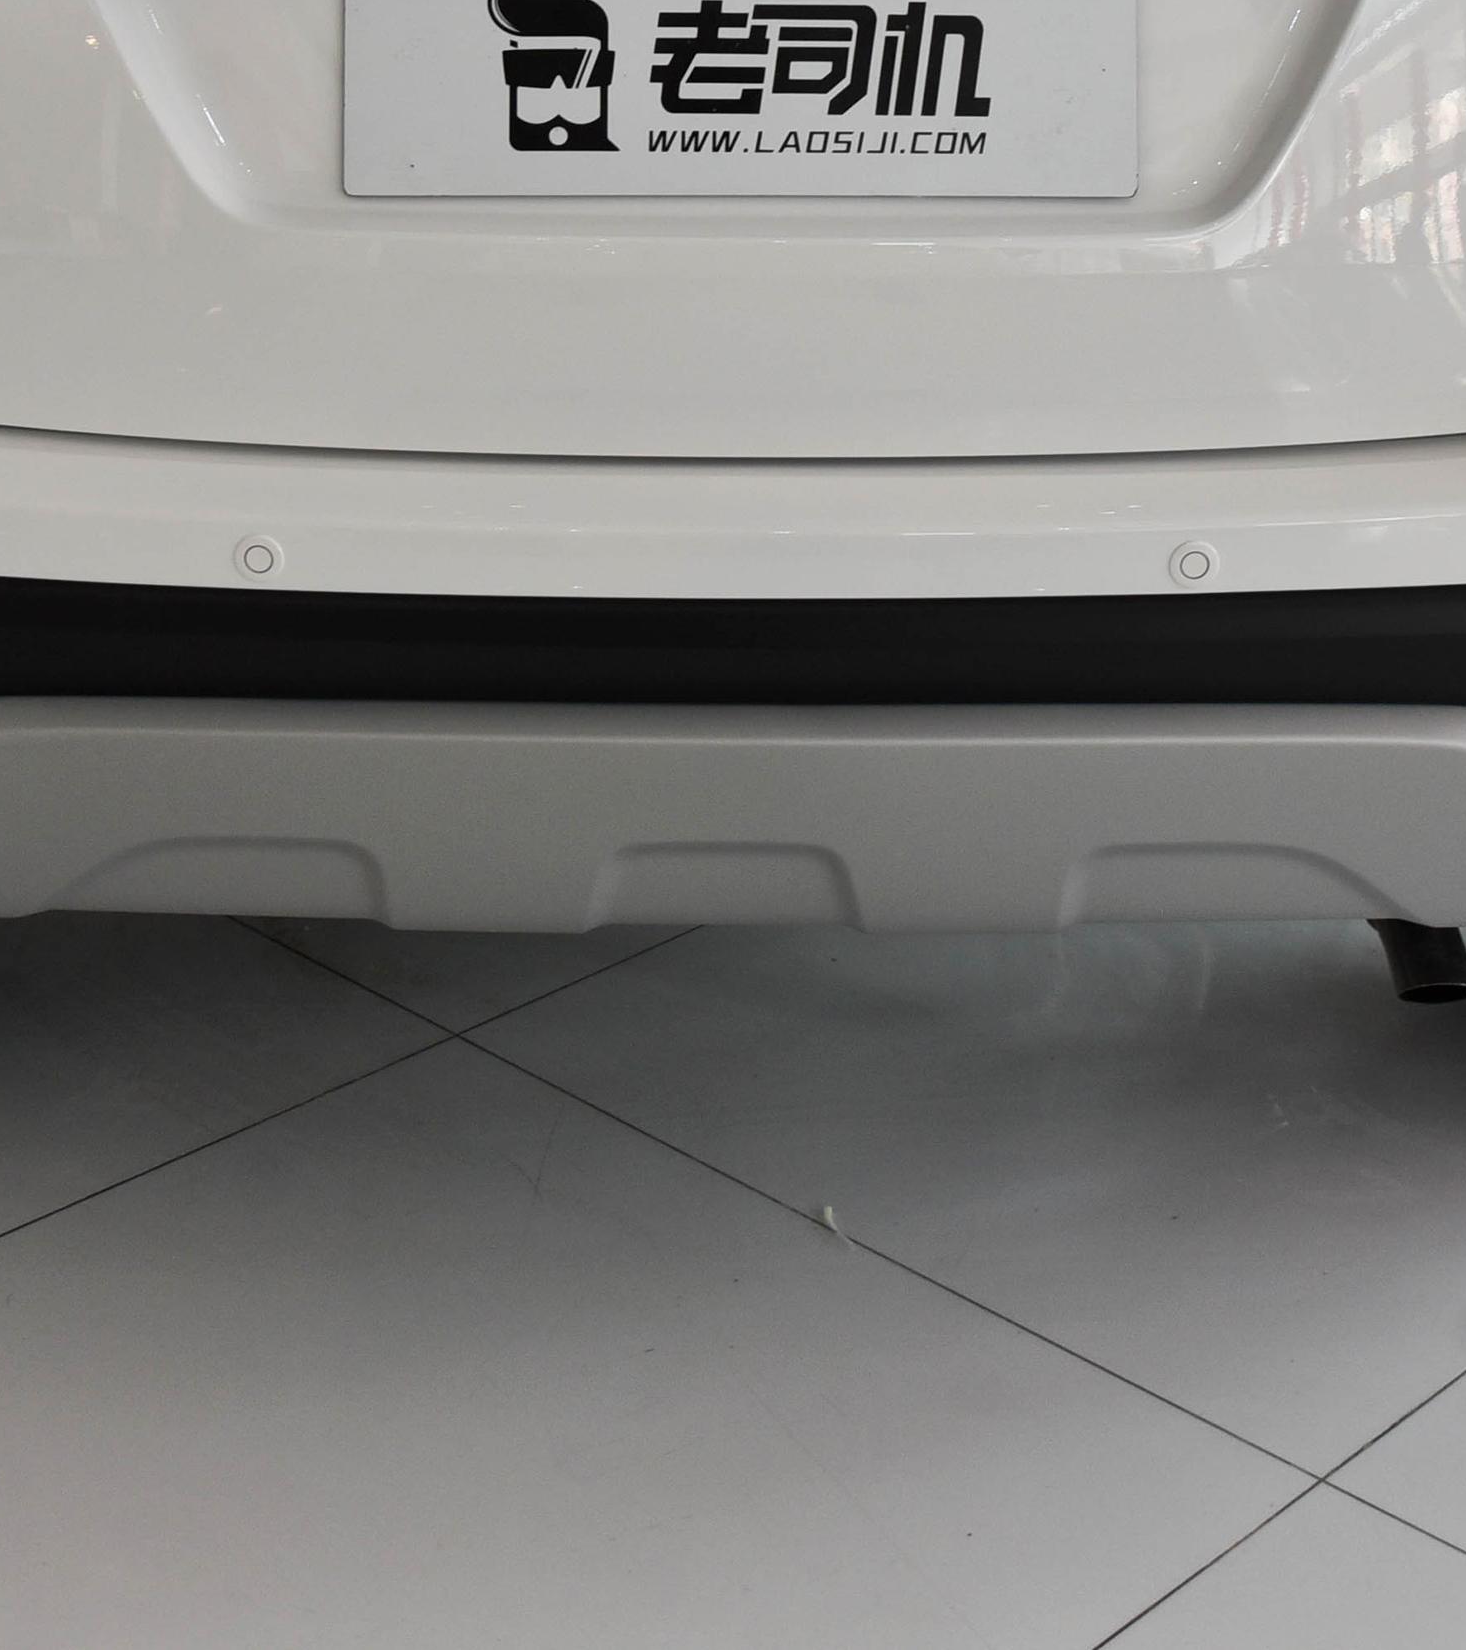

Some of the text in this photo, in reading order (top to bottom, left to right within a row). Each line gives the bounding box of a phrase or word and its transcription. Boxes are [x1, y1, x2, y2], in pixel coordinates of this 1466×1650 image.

[649, 0, 991, 117] 老司机
[648, 129, 987, 155] WWW.LAOSIJI.COM
